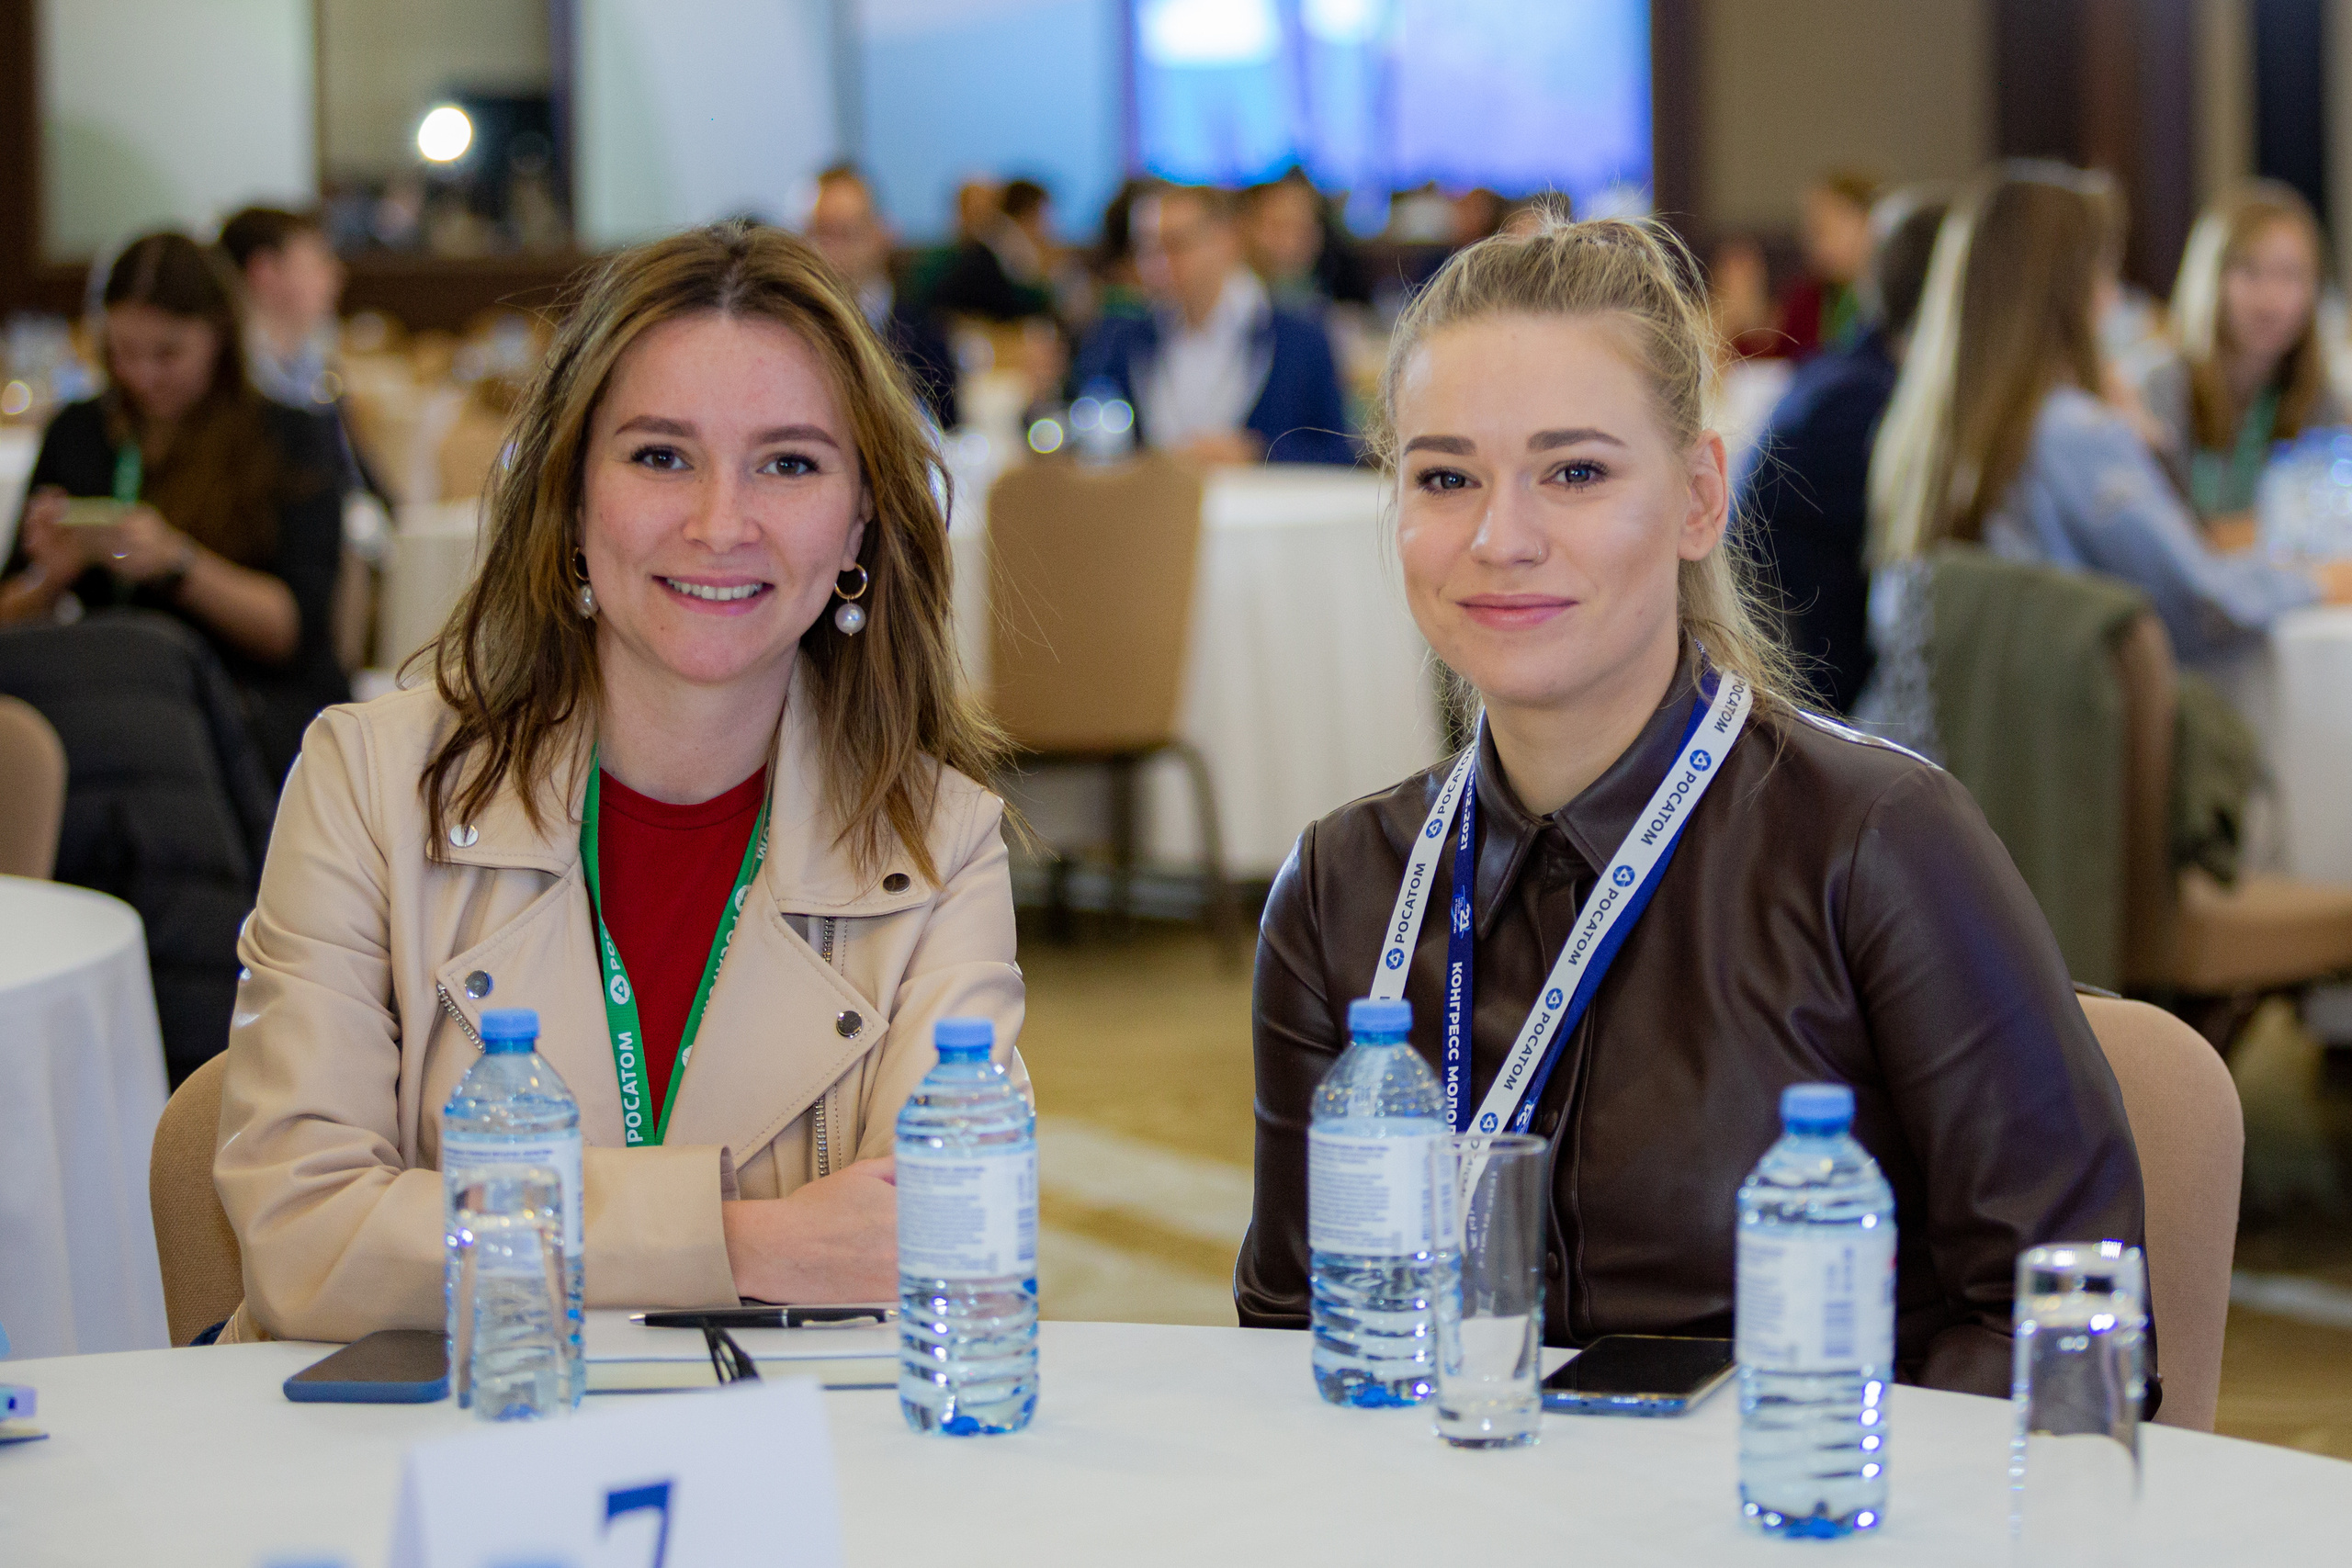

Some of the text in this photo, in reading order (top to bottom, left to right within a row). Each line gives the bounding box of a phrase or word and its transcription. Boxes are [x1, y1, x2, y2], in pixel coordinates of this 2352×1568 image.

[1713, 677, 1747, 734] РОСАТОМ
[1640, 771, 1697, 846] РОСАТОМ
[1394, 863, 1427, 944] РОСАТОМ
[1567, 887, 1620, 965] РОСАТОМ
[1448, 961, 1464, 1061] КОНГРЕСС
[1503, 1011, 1551, 1090] РОСАТОМ
[617, 1031, 644, 1143] РОСАТОМ
[600, 1479, 674, 1568] 7
